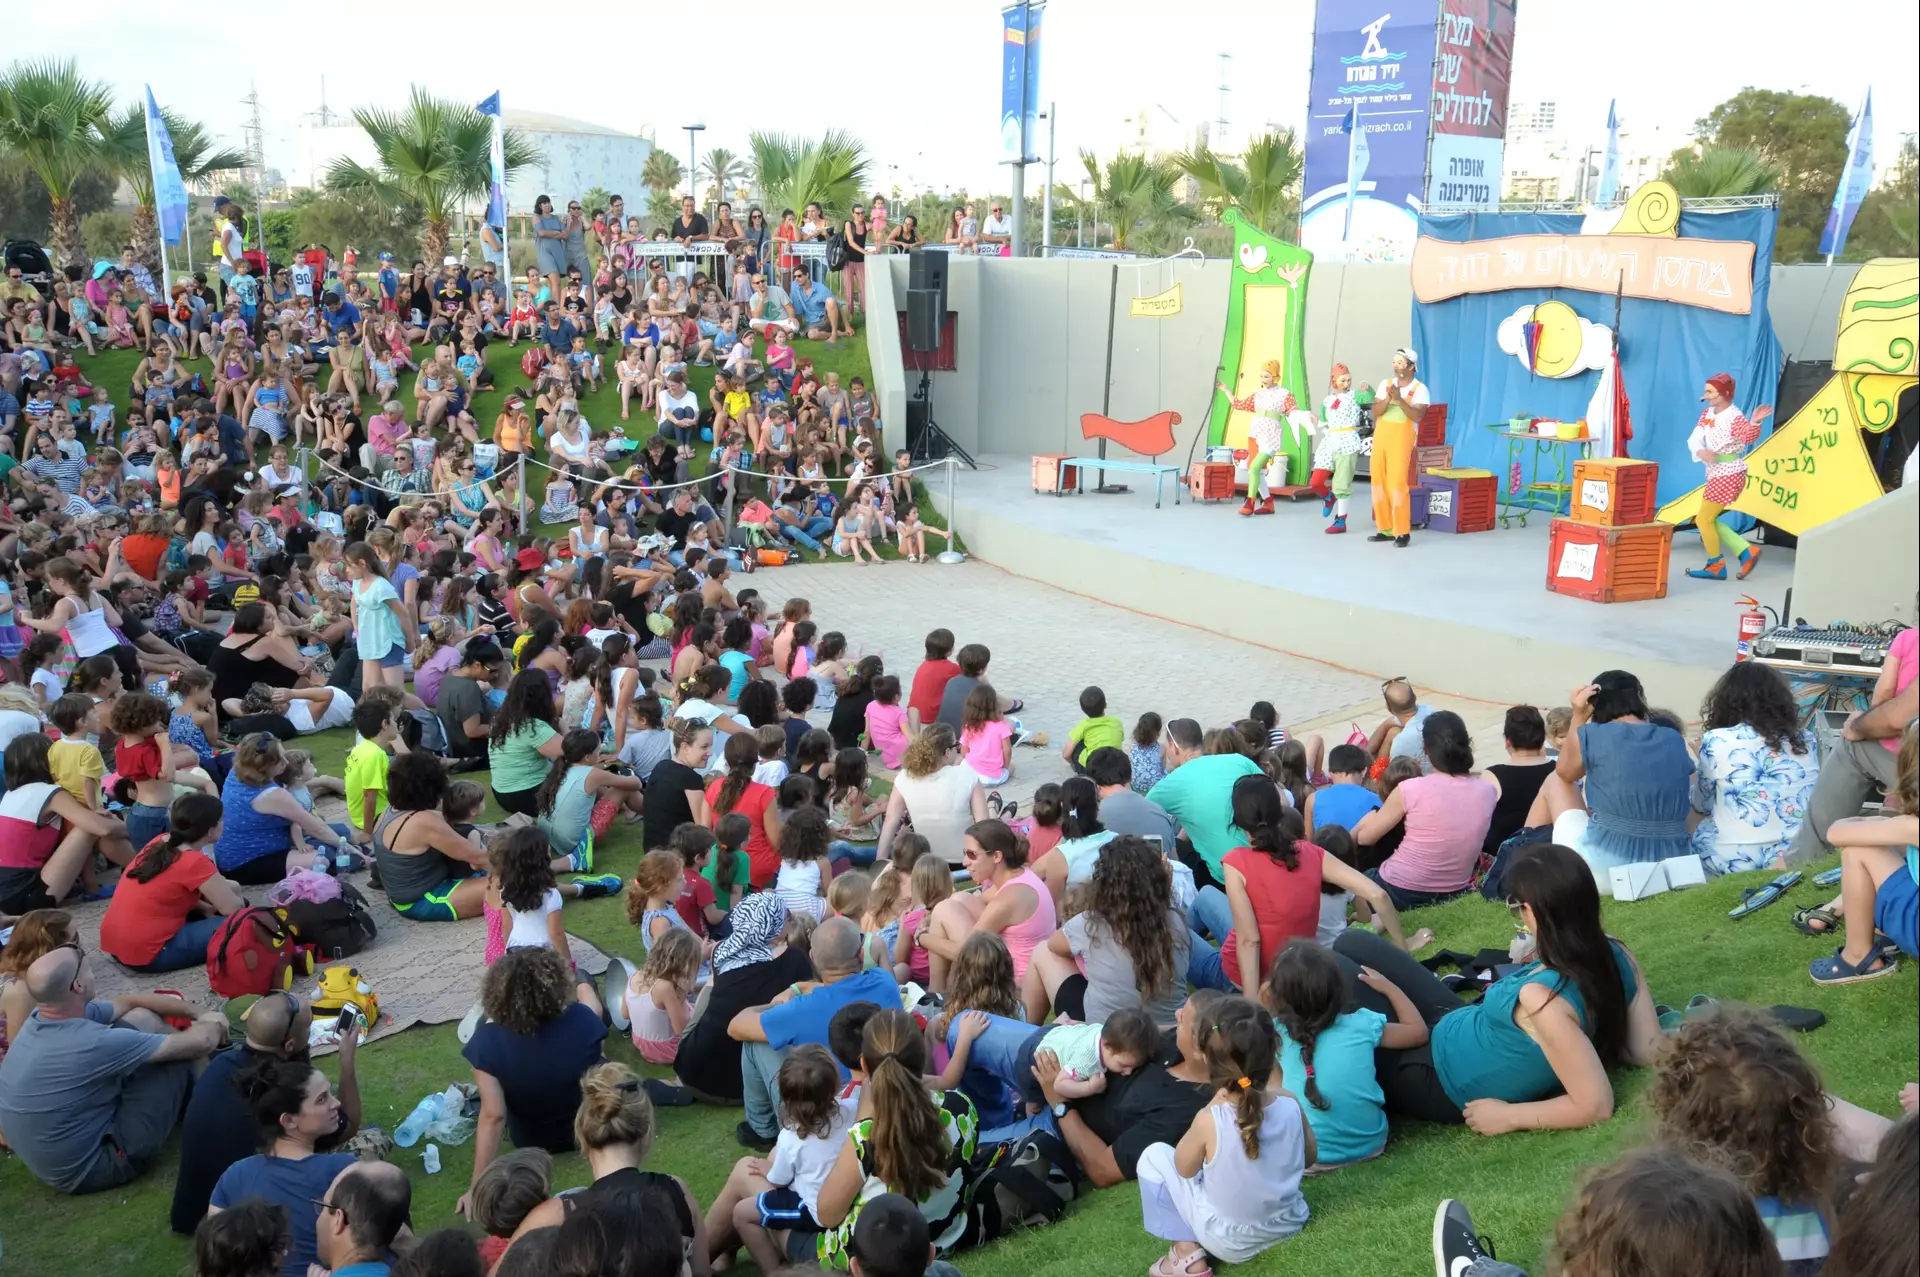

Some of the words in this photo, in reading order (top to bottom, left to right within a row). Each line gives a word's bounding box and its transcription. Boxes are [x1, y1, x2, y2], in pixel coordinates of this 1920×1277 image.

[1434, 86, 1493, 126] לגדולים
[1449, 157, 1484, 177] אופרה
[1439, 182, 1489, 203] בטריבונה
[296, 273, 311, 285] 90
[1652, 256, 1732, 297] מחסן
[1817, 407, 1839, 426] מי
[1799, 429, 1838, 454] שלא
[1765, 455, 1816, 475] מביט
